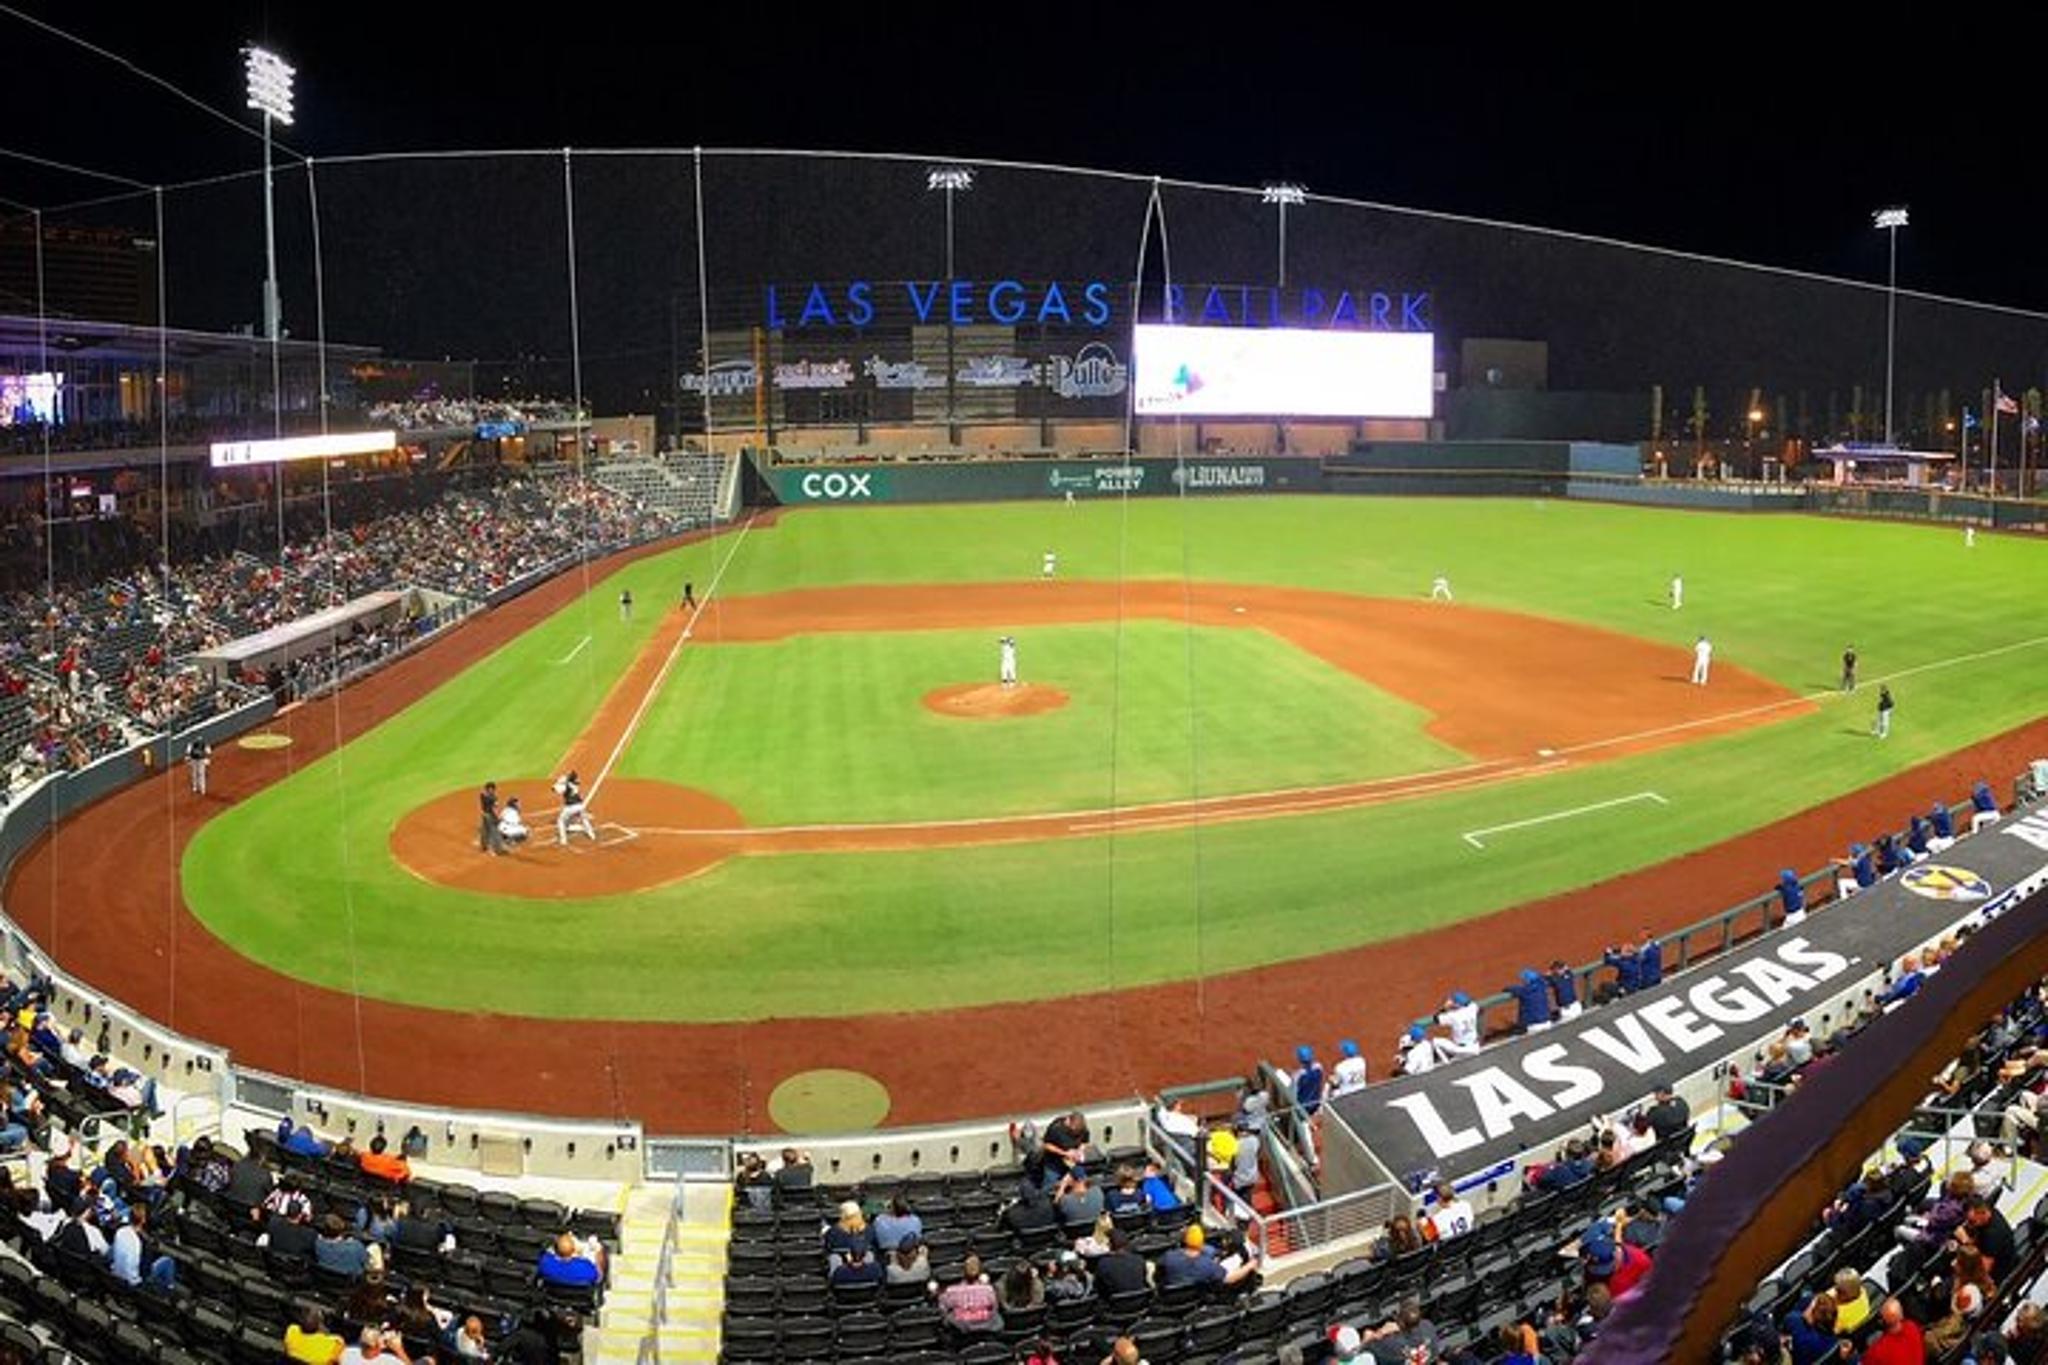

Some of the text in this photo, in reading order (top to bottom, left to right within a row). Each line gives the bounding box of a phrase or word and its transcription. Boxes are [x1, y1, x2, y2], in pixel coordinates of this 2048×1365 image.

[766, 280, 1433, 330] LAS VEGAS BALLPARK
[801, 472, 871, 498] COX
[1097, 478, 1142, 491] ALLEY
[1387, 1043, 1605, 1159] LAS
